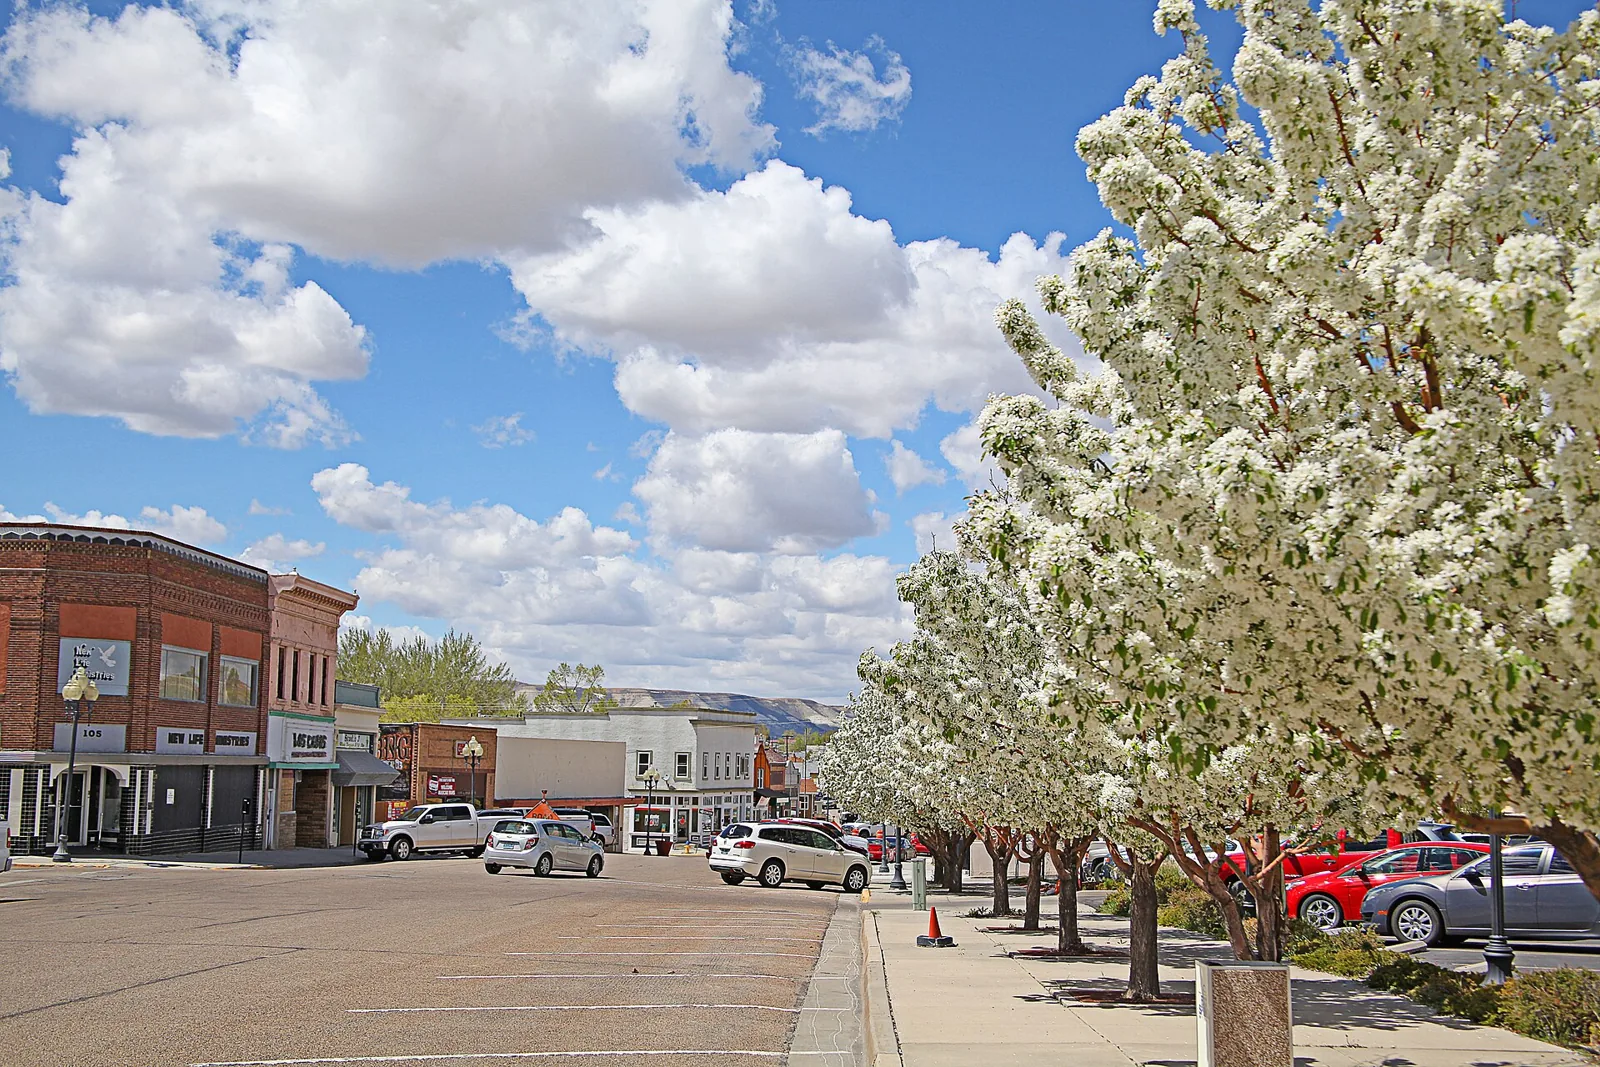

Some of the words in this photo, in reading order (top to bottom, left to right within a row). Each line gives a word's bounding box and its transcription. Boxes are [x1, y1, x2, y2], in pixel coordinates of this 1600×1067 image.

[74, 643, 95, 657] New
[83, 730, 102, 738] 105
[168, 732, 185, 744] NEW
[188, 733, 204, 745] LIFE
